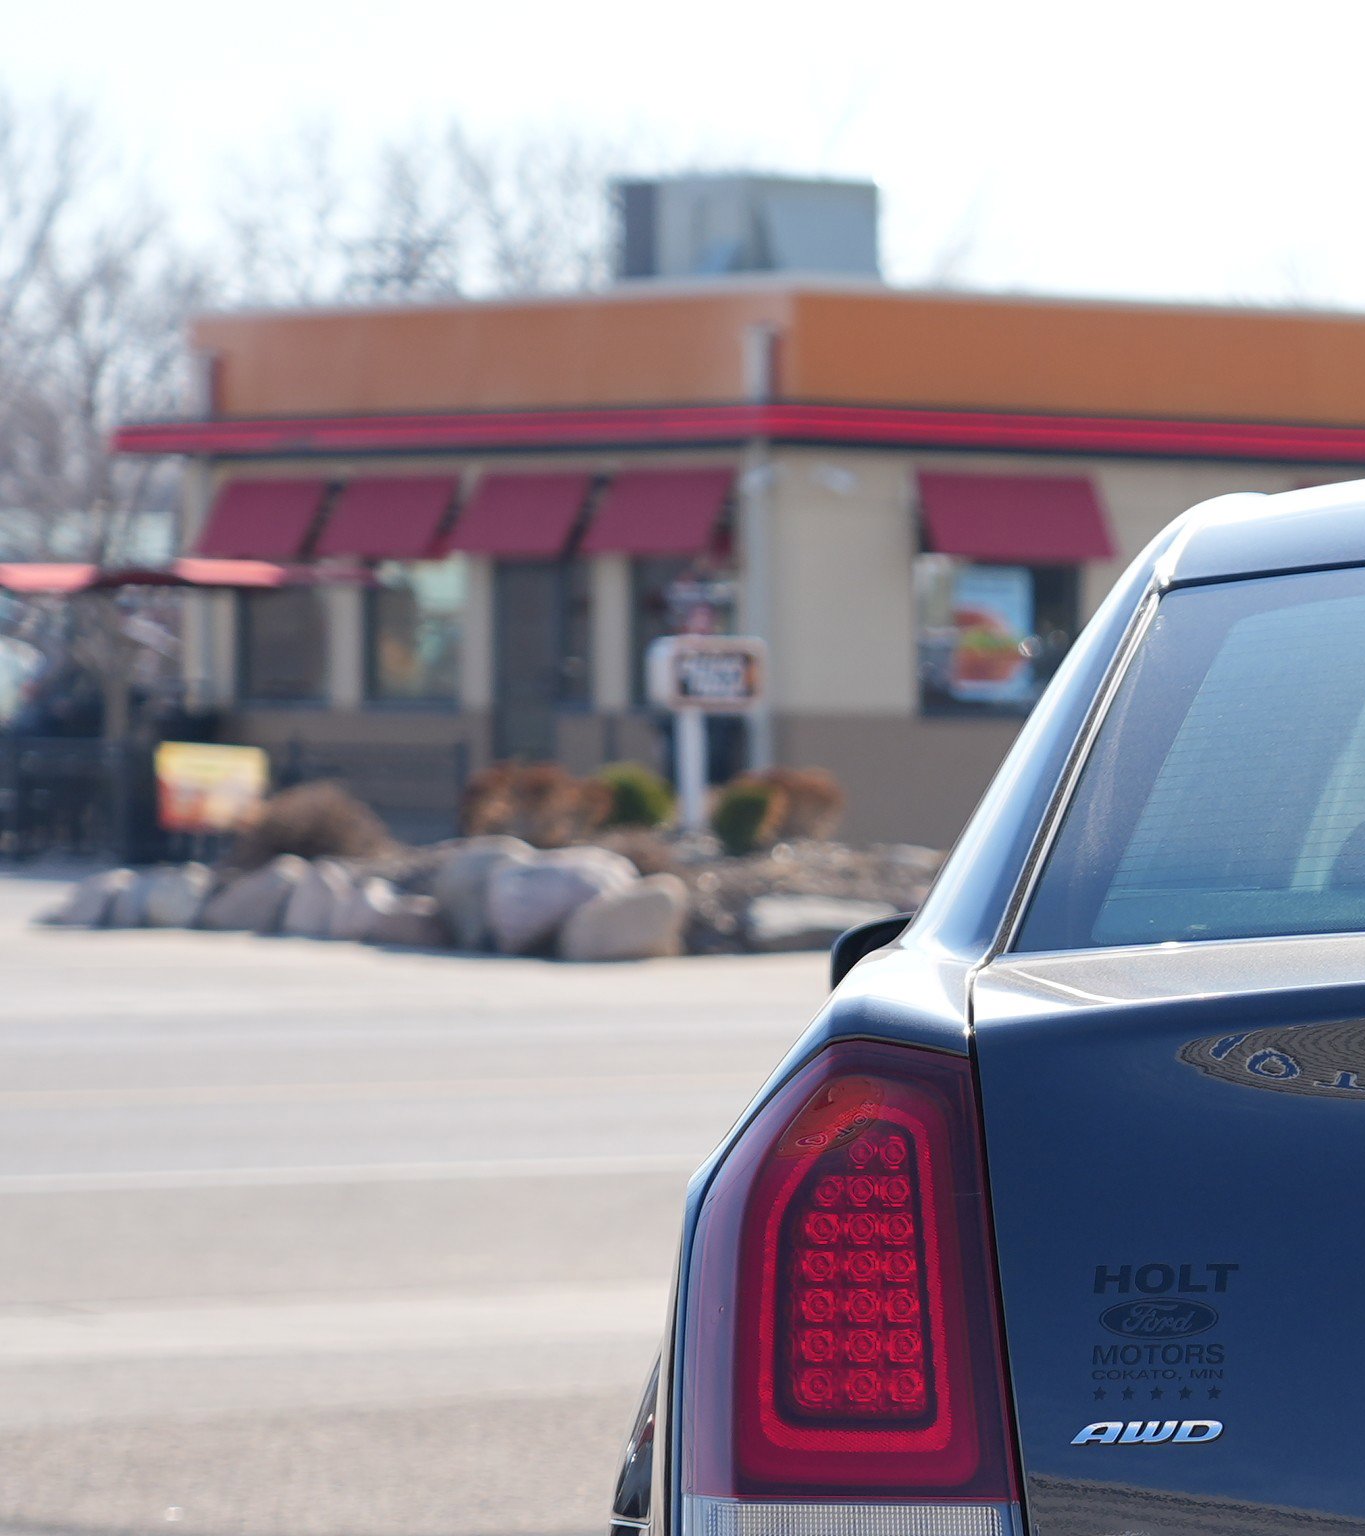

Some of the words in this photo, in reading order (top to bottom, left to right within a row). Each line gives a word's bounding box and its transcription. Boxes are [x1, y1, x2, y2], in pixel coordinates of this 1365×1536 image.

[1093, 1263, 1240, 1295] HOLT
[1121, 1303, 1197, 1333] Ford
[1091, 1343, 1226, 1366] MOTORS
[1090, 1368, 1183, 1382] COKATO,
[1189, 1368, 1224, 1380] MN
[1069, 1419, 1225, 1445] AWD
